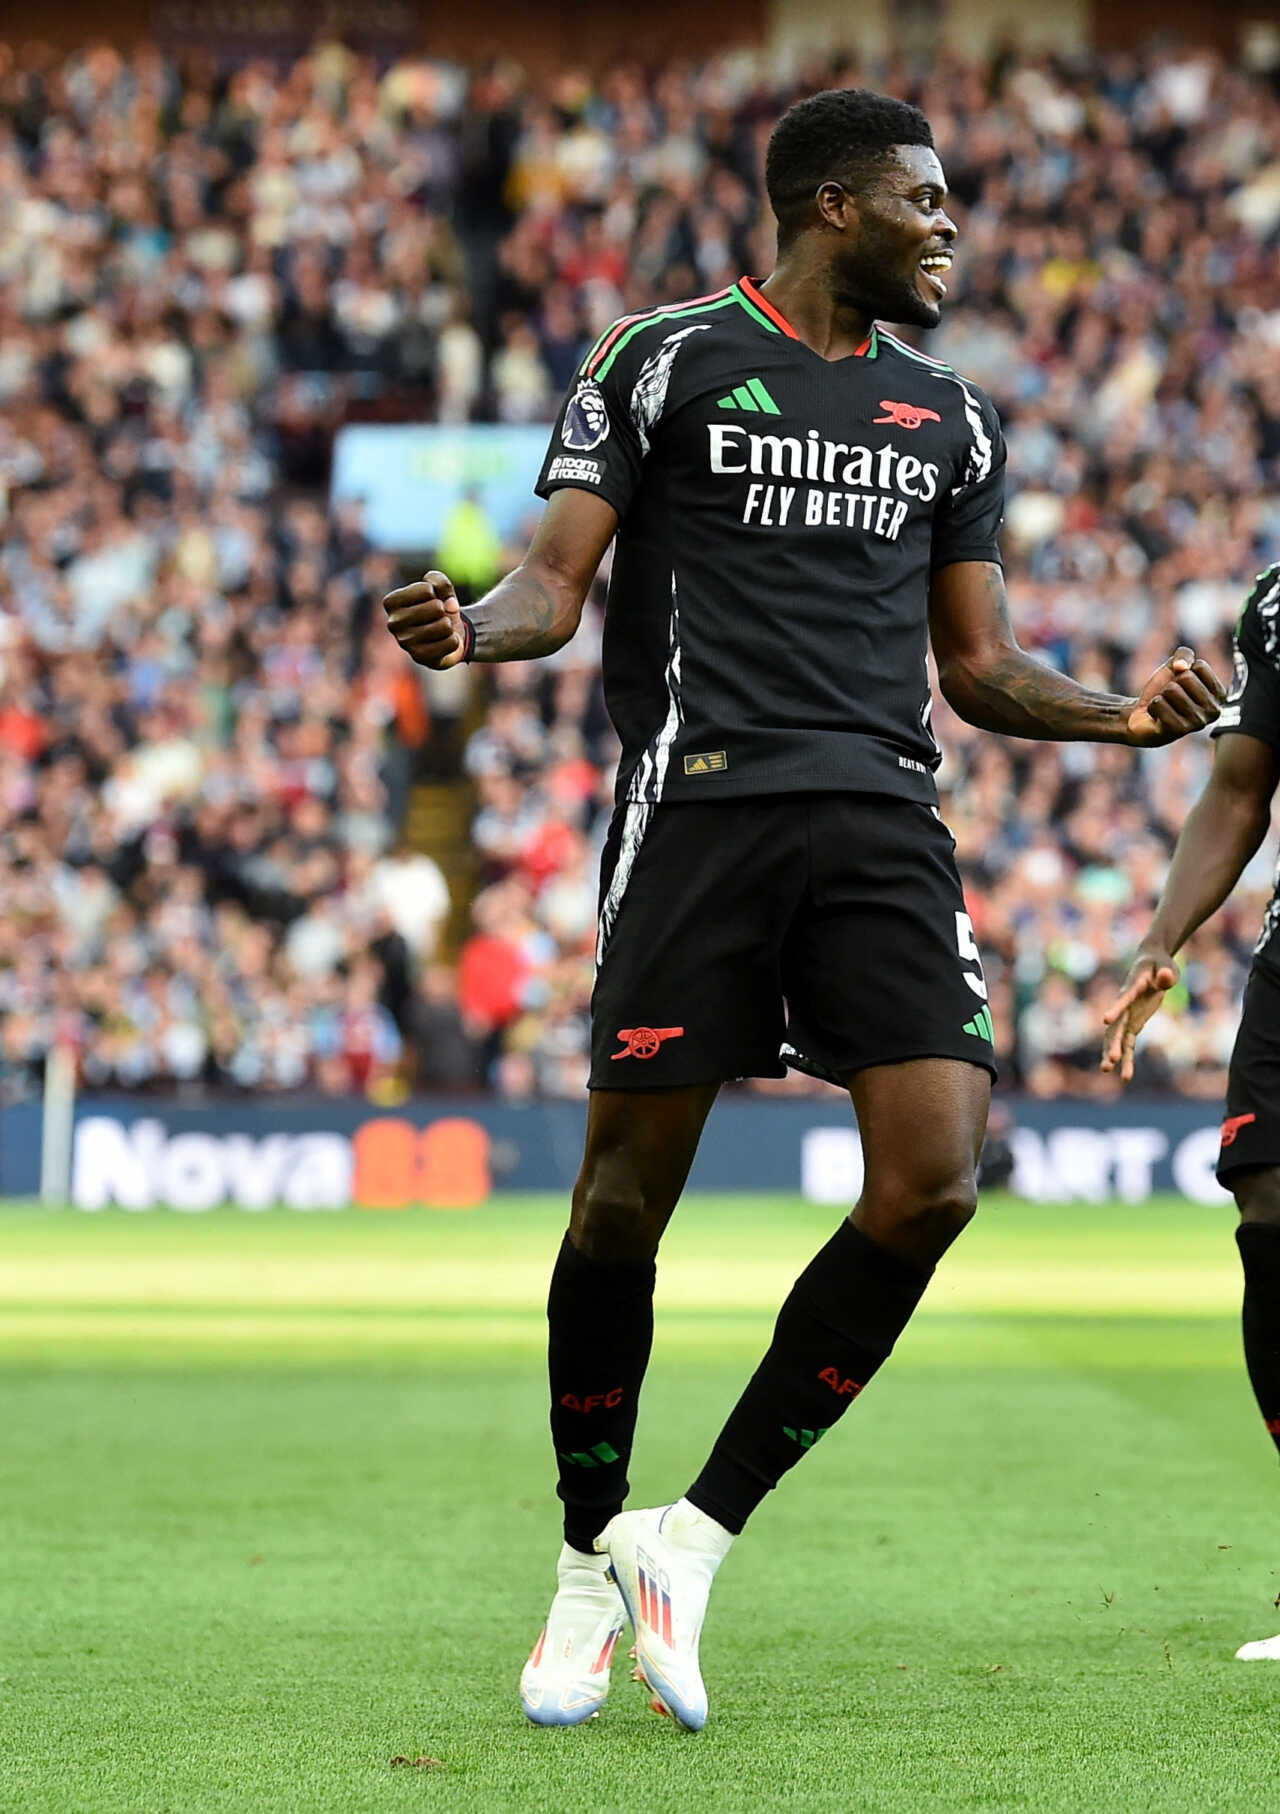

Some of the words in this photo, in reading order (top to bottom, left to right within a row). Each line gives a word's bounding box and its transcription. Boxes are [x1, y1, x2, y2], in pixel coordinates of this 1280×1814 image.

[558, 468, 601, 485] racism
[562, 457, 599, 473] room
[707, 424, 939, 502] Emirates
[743, 482, 794, 527] FLY
[805, 489, 909, 542] BETTER
[955, 911, 989, 1001] 5
[561, 1387, 624, 1414] AFC
